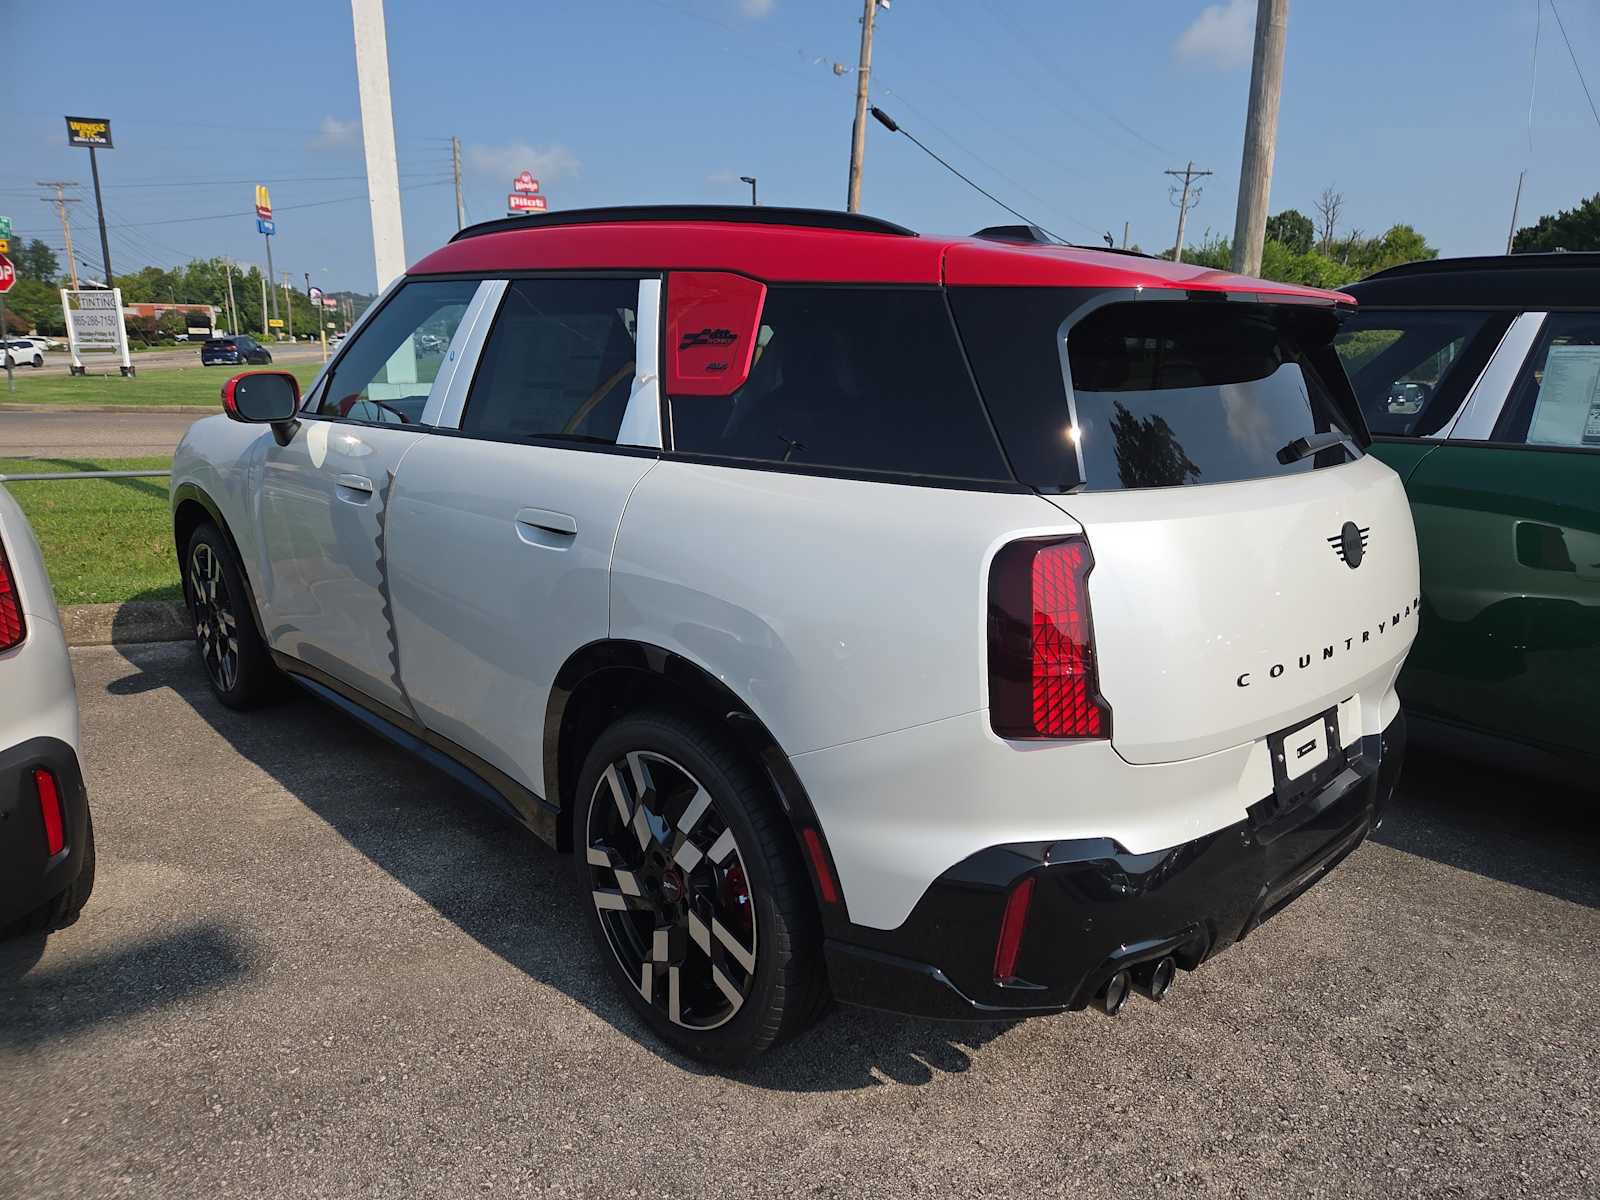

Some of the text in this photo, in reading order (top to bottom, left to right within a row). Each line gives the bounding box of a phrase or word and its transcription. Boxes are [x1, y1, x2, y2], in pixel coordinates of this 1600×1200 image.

[70, 121, 106, 132] WINGS
[510, 196, 545, 208] Pilot
[81, 297, 116, 307] TINTING
[1237, 597, 1419, 687] COUNTRYMAN
